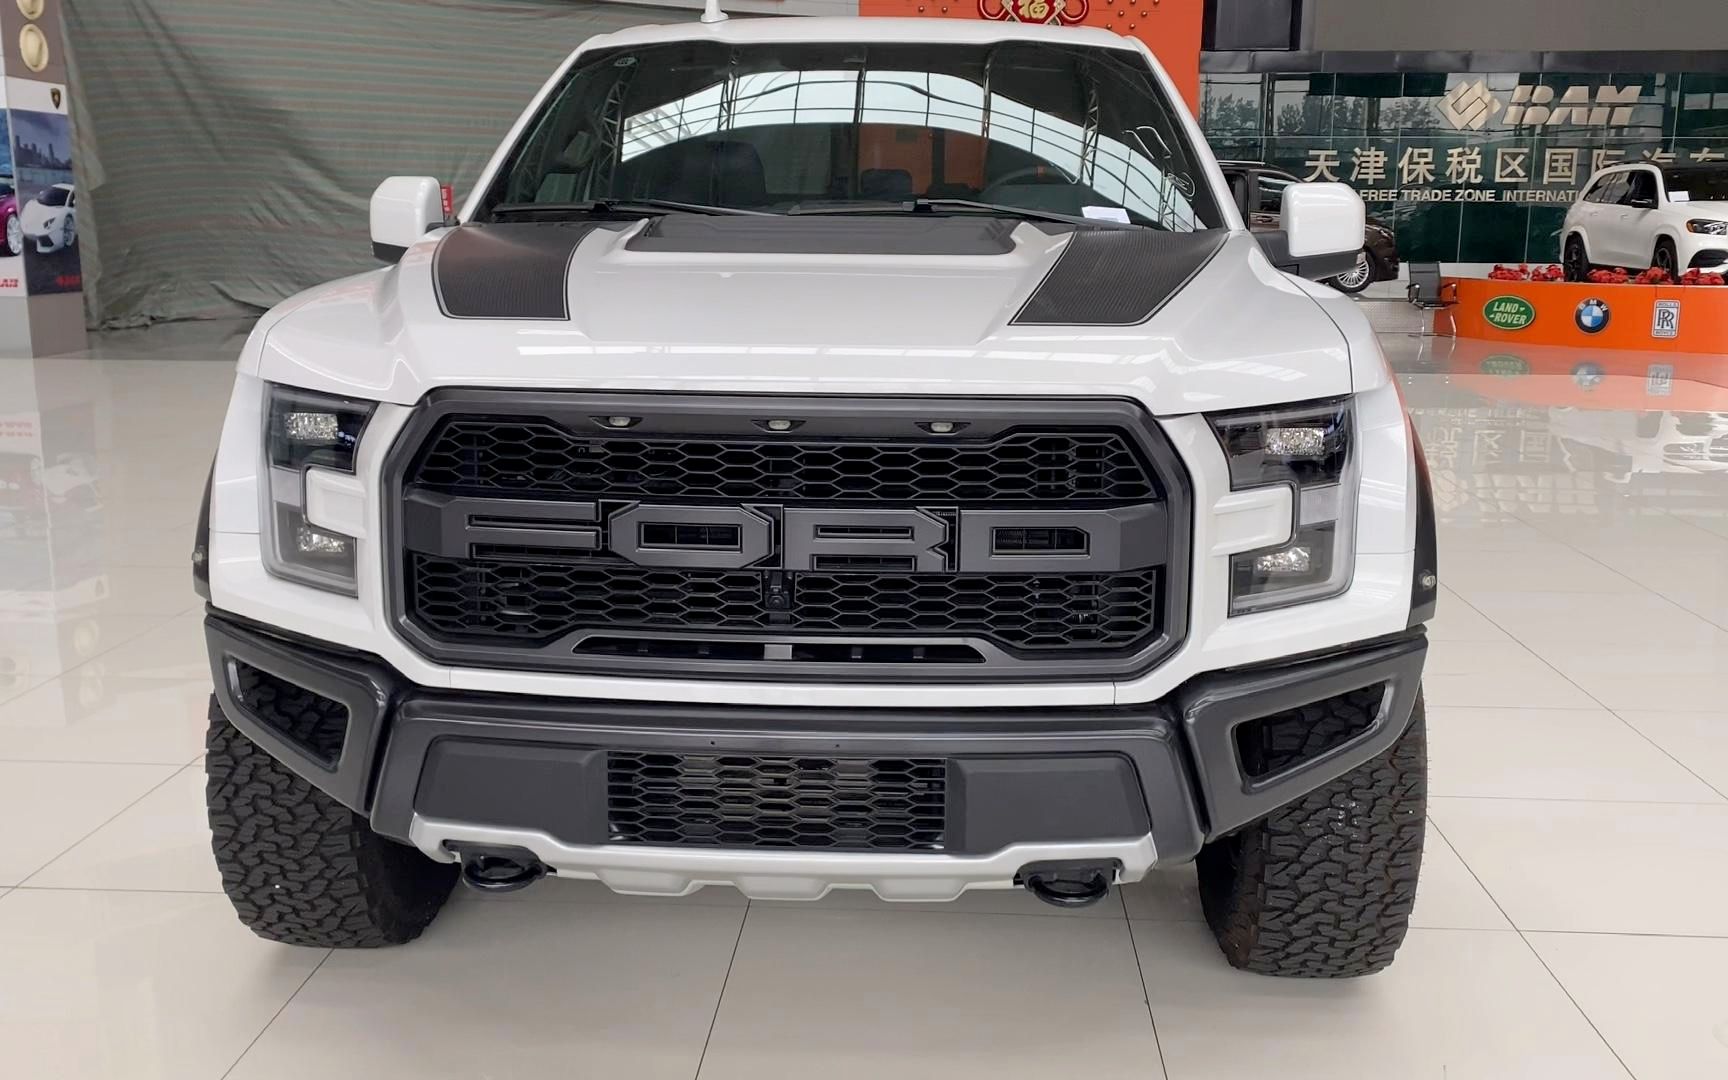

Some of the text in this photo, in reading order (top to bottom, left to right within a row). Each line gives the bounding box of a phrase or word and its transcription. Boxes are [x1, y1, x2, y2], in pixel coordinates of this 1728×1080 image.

[1360, 189, 1398, 201] FREE
[1401, 189, 1451, 202] TRADE
[1454, 189, 1496, 202] ZONE
[1493, 302, 1519, 313] LAND
[1494, 313, 1527, 325] ROVER
[445, 498, 1110, 574] FORD
